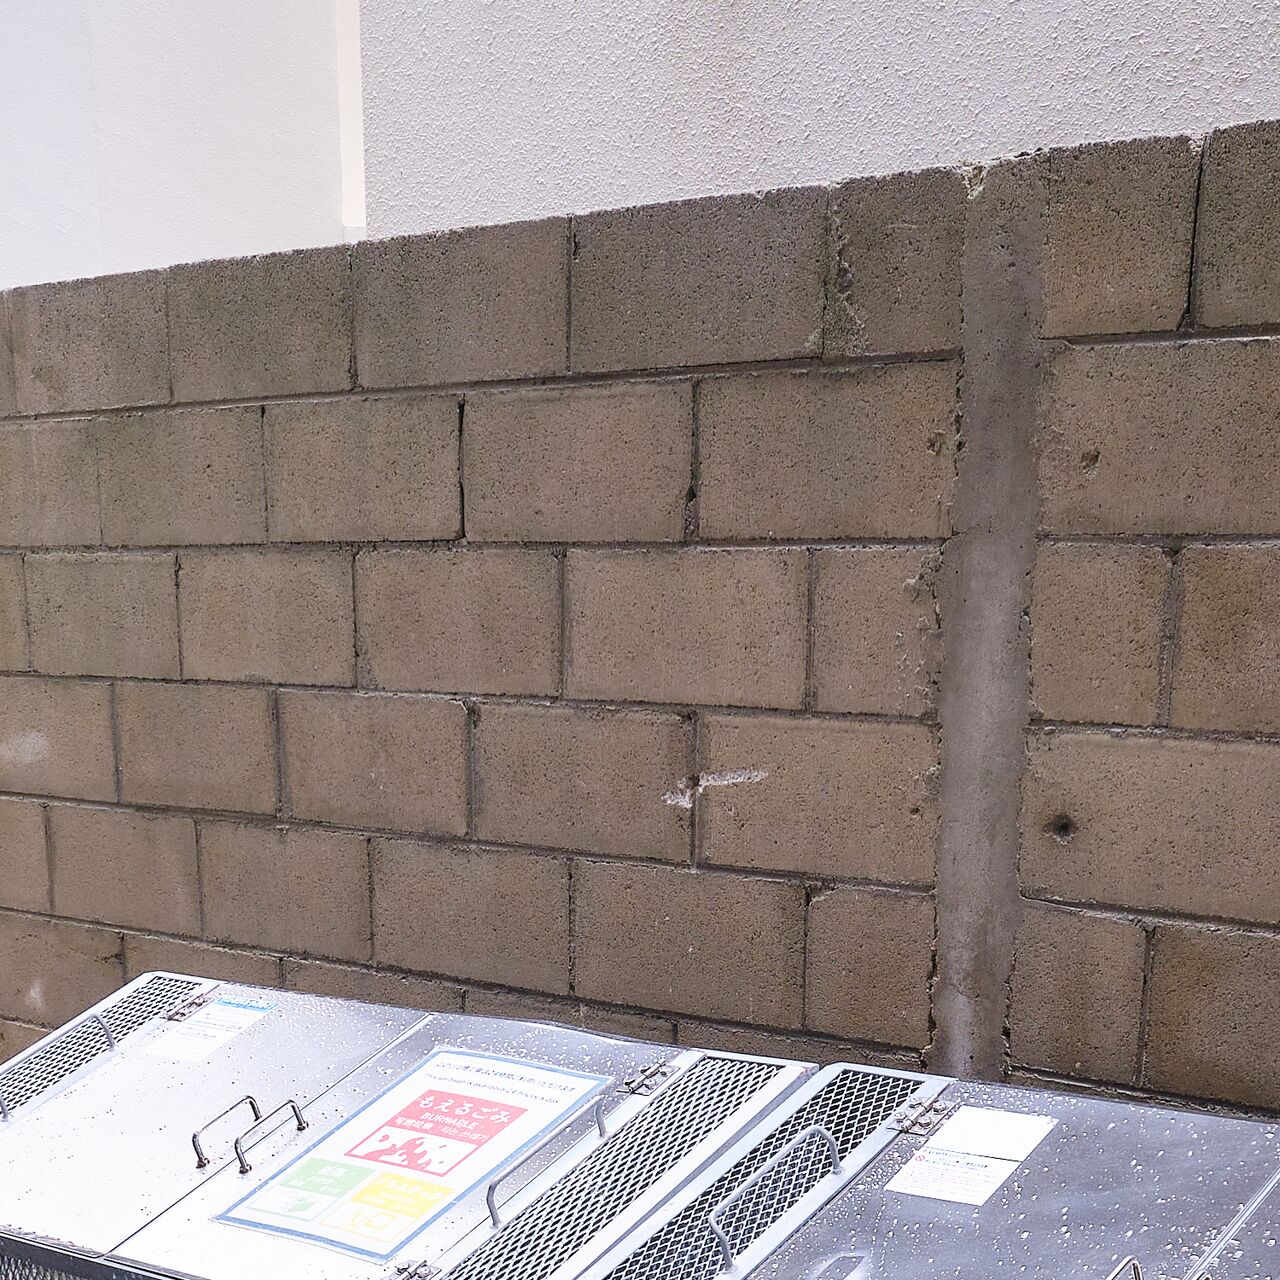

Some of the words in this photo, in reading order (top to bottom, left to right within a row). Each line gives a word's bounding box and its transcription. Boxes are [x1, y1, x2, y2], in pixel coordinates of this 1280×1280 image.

[418, 1094, 511, 1125] もえるごみ
[419, 1112, 479, 1131] BURNABLE
